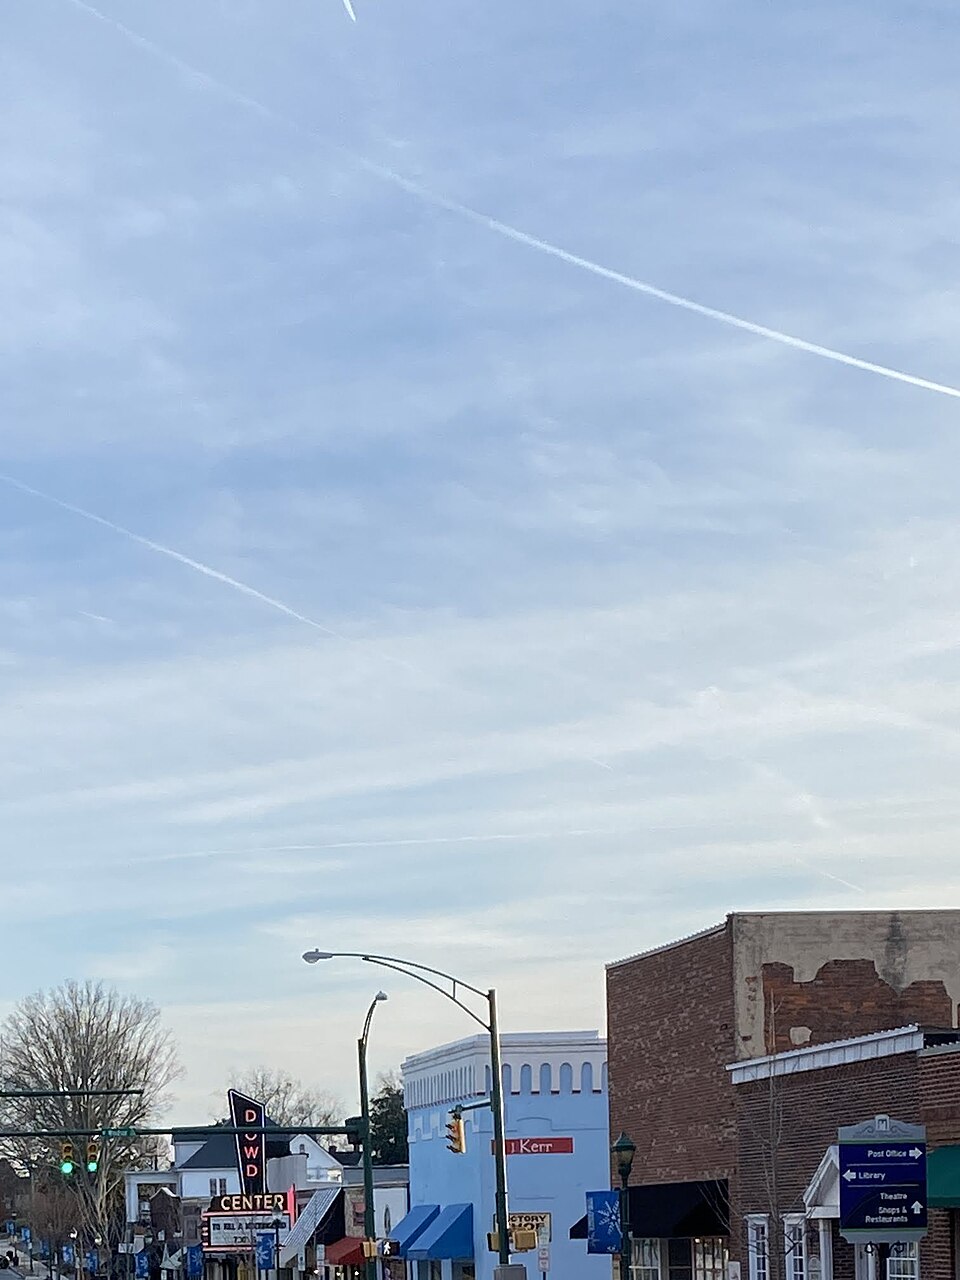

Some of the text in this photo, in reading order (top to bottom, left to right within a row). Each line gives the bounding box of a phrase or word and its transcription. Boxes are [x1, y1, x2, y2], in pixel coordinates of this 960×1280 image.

[519, 1139, 553, 1153] Kerr
[867, 1149, 907, 1158] Post Office
[858, 1172, 886, 1181] Library
[880, 1192, 908, 1200] Theatre
[221, 1195, 284, 1211] CENTER
[878, 1206, 908, 1215] Shops &
[865, 1215, 908, 1223] Restaurants
